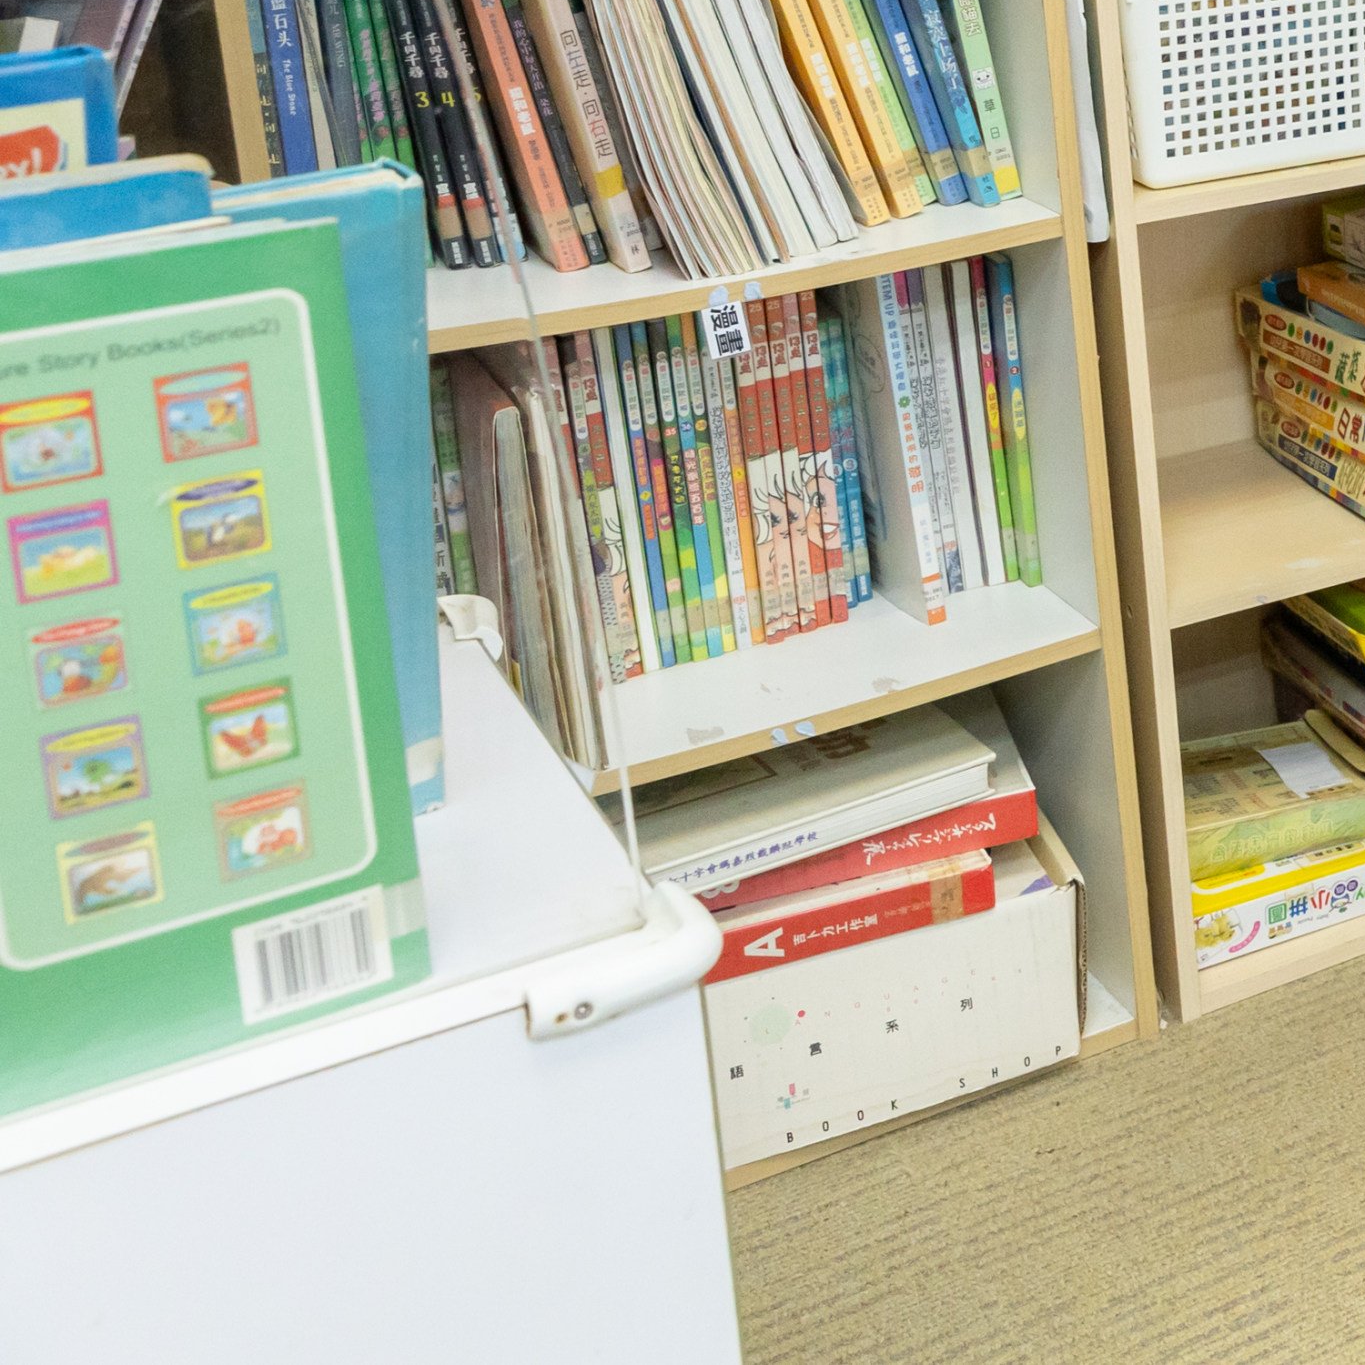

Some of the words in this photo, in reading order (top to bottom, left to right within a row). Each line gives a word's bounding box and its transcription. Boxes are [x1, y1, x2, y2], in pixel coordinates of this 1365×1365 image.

[414, 90, 430, 110] 3
[440, 90, 456, 110] 4
[767, 300, 782, 313] 25
[37, 341, 100, 377] Story
[105, 315, 281, 364] Books(Series2)
[709, 304, 745, 358] 漫畫
[1268, 889, 1332, 927] 小拼圖
[744, 926, 786, 959] A
[792, 914, 879, 947] 吉卜力工作室
[786, 1098, 899, 1144] BOOK
[958, 1044, 1062, 1090] SHOP
